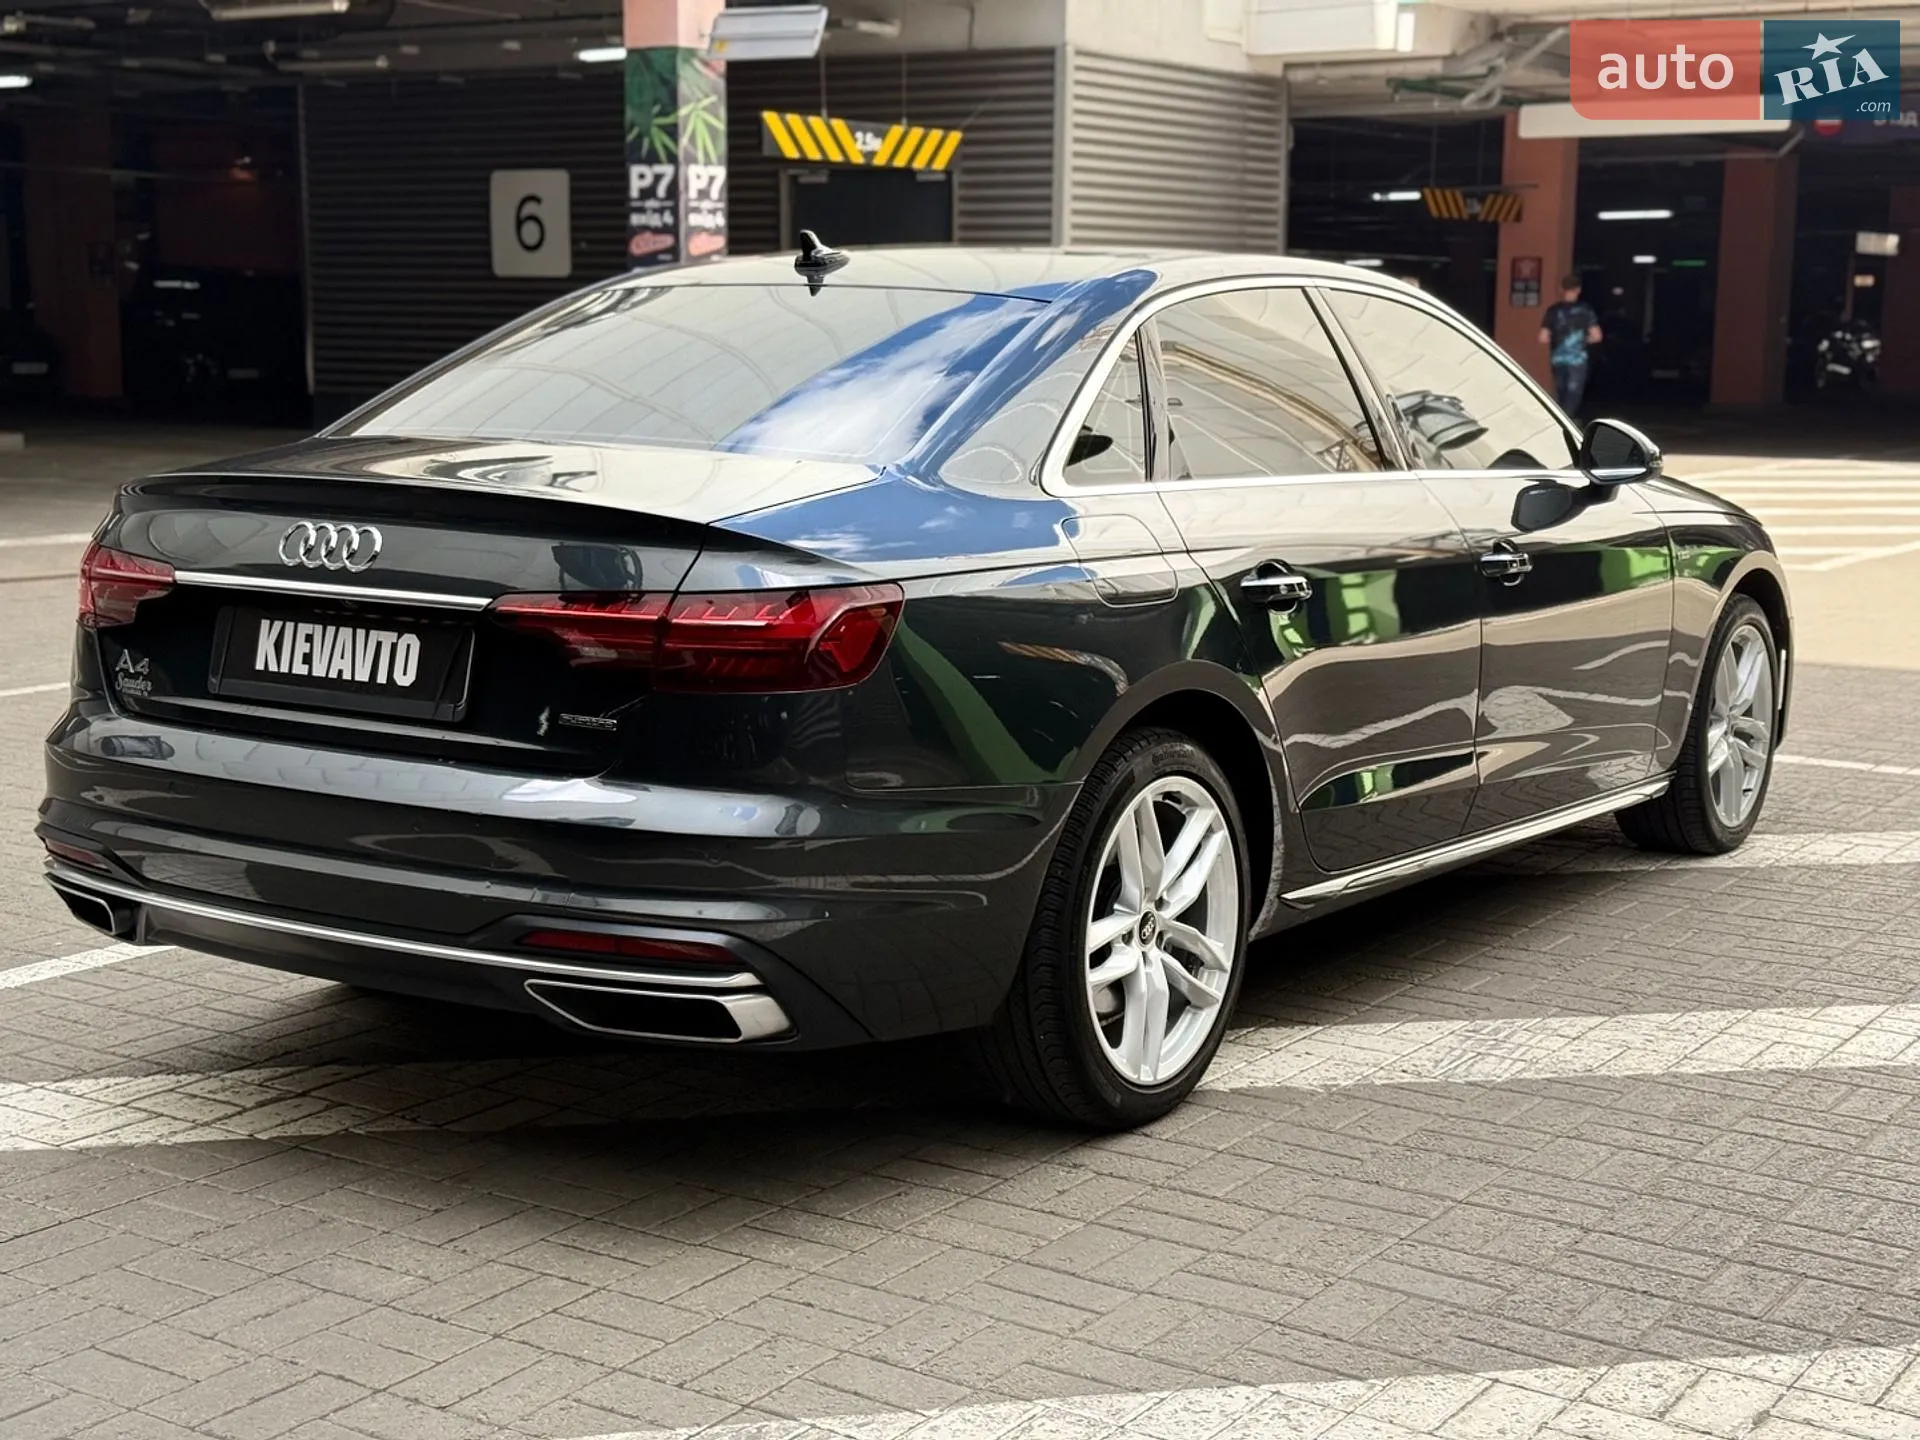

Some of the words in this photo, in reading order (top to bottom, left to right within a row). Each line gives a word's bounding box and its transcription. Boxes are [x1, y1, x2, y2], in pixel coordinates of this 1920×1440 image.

[629, 163, 675, 200] P7
[687, 163, 727, 201] P7
[515, 193, 546, 253] 6
[255, 618, 421, 687] KIEVAVTO
